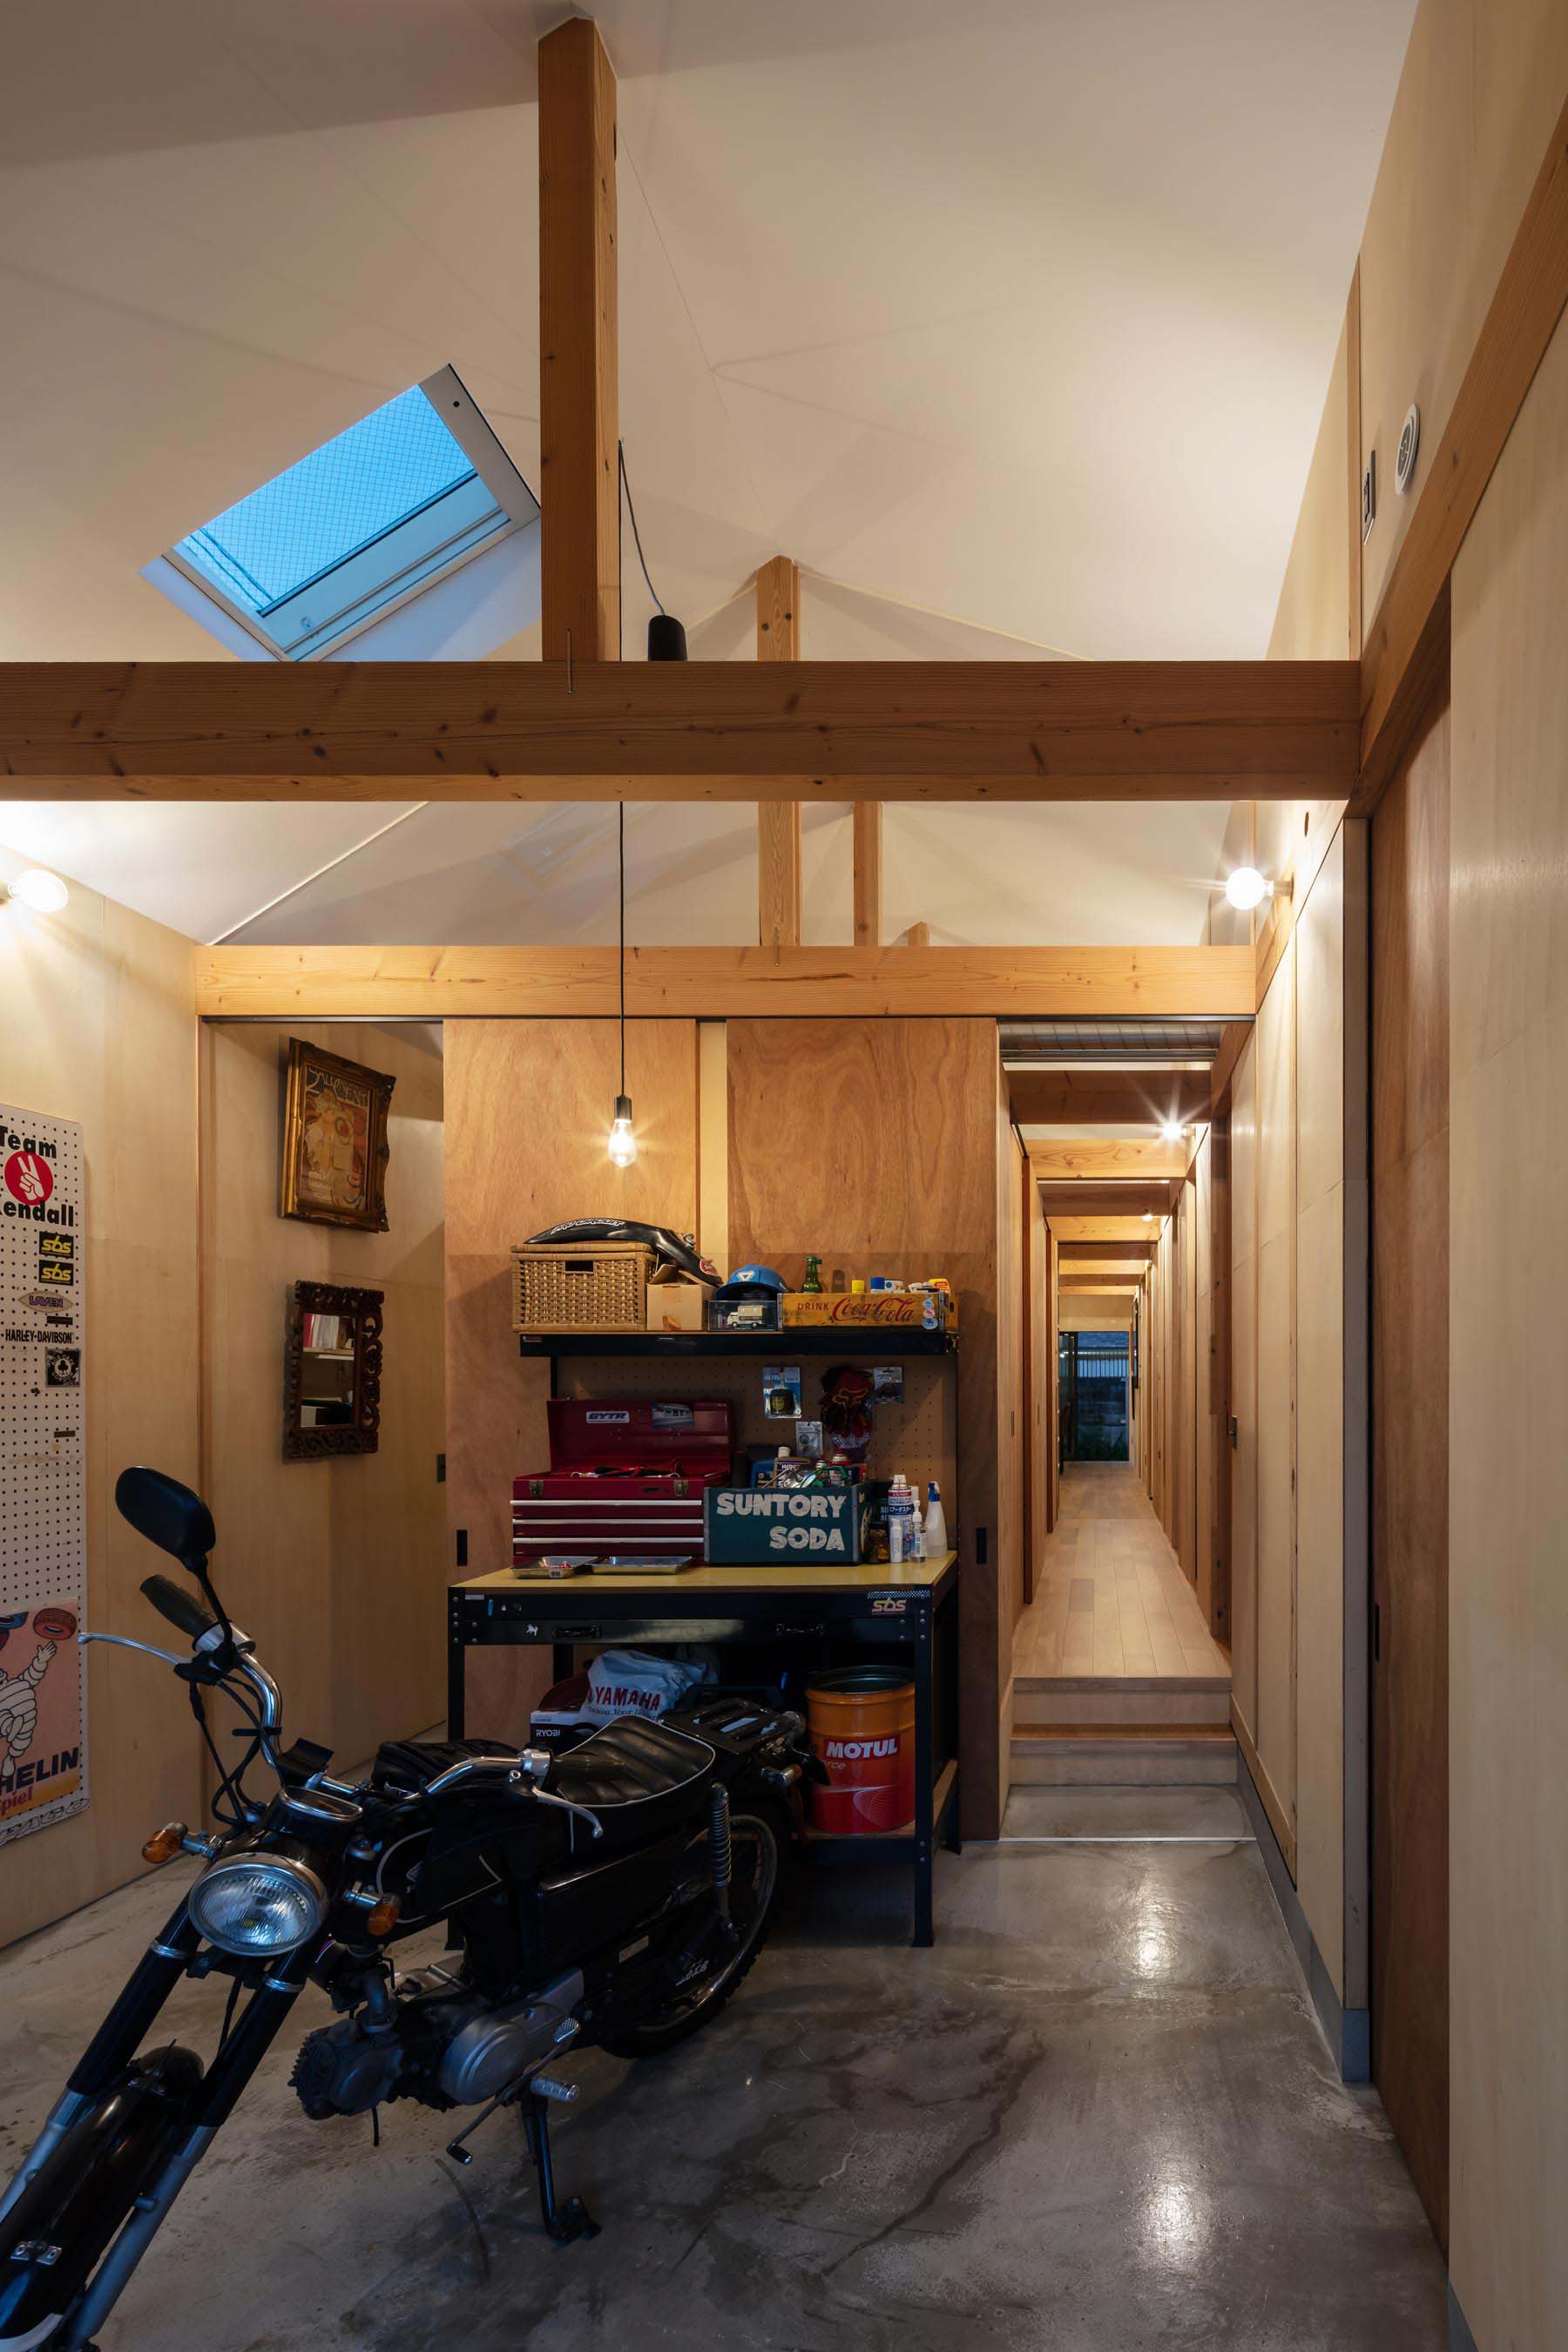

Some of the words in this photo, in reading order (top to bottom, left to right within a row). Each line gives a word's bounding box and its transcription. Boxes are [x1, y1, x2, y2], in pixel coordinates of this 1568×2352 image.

[0, 1125, 57, 1159] Team
[0, 1199, 74, 1227] endall
[41, 1235, 71, 1254] sbs
[41, 1263, 71, 1281] sbs
[797, 1302, 829, 1311] DRINK
[832, 1297, 916, 1322] Coca-Cola
[717, 1492, 847, 1518] SUNTORY
[769, 1525, 845, 1551] SODA
[595, 1686, 661, 1711] YAMAHA
[536, 1729, 561, 1738] RYOBI
[826, 1738, 898, 1759] MOTUL
[822, 1758, 847, 1770] rce
